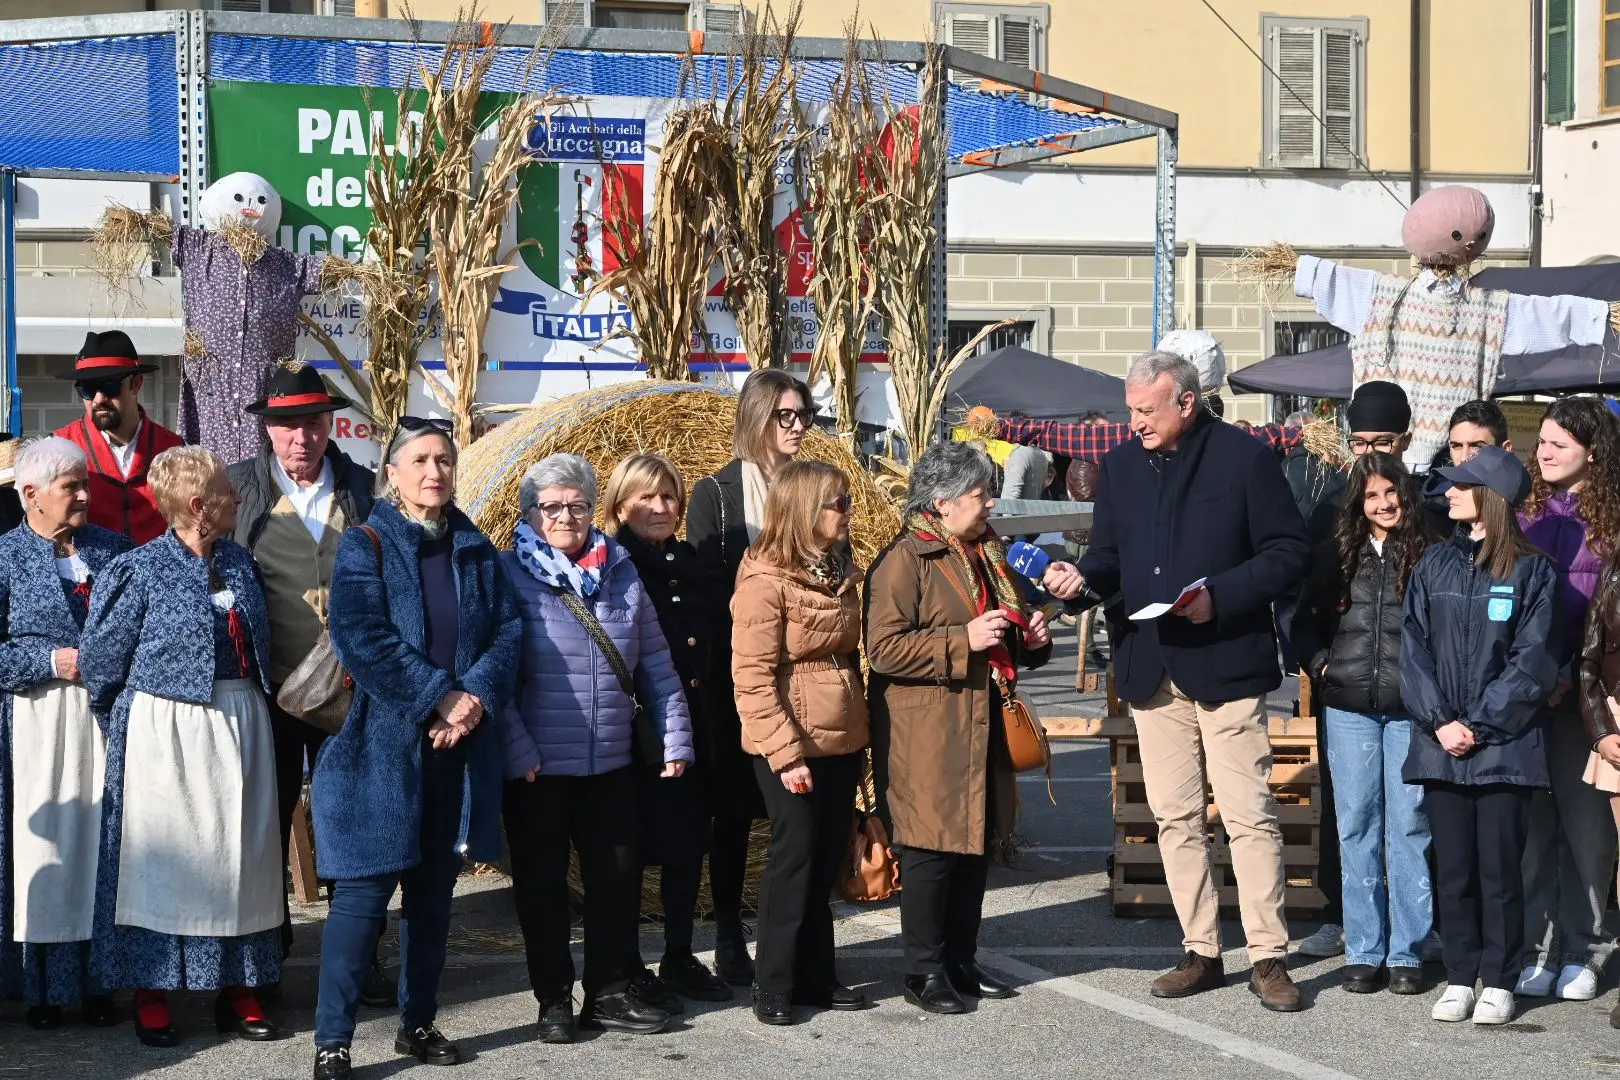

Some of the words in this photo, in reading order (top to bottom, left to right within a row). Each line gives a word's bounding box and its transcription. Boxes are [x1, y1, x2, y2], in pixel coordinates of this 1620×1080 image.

[550, 122, 565, 133] Gli
[617, 124, 642, 136] della
[536, 312, 627, 338] ITALIA
[723, 337, 741, 349] Gli
